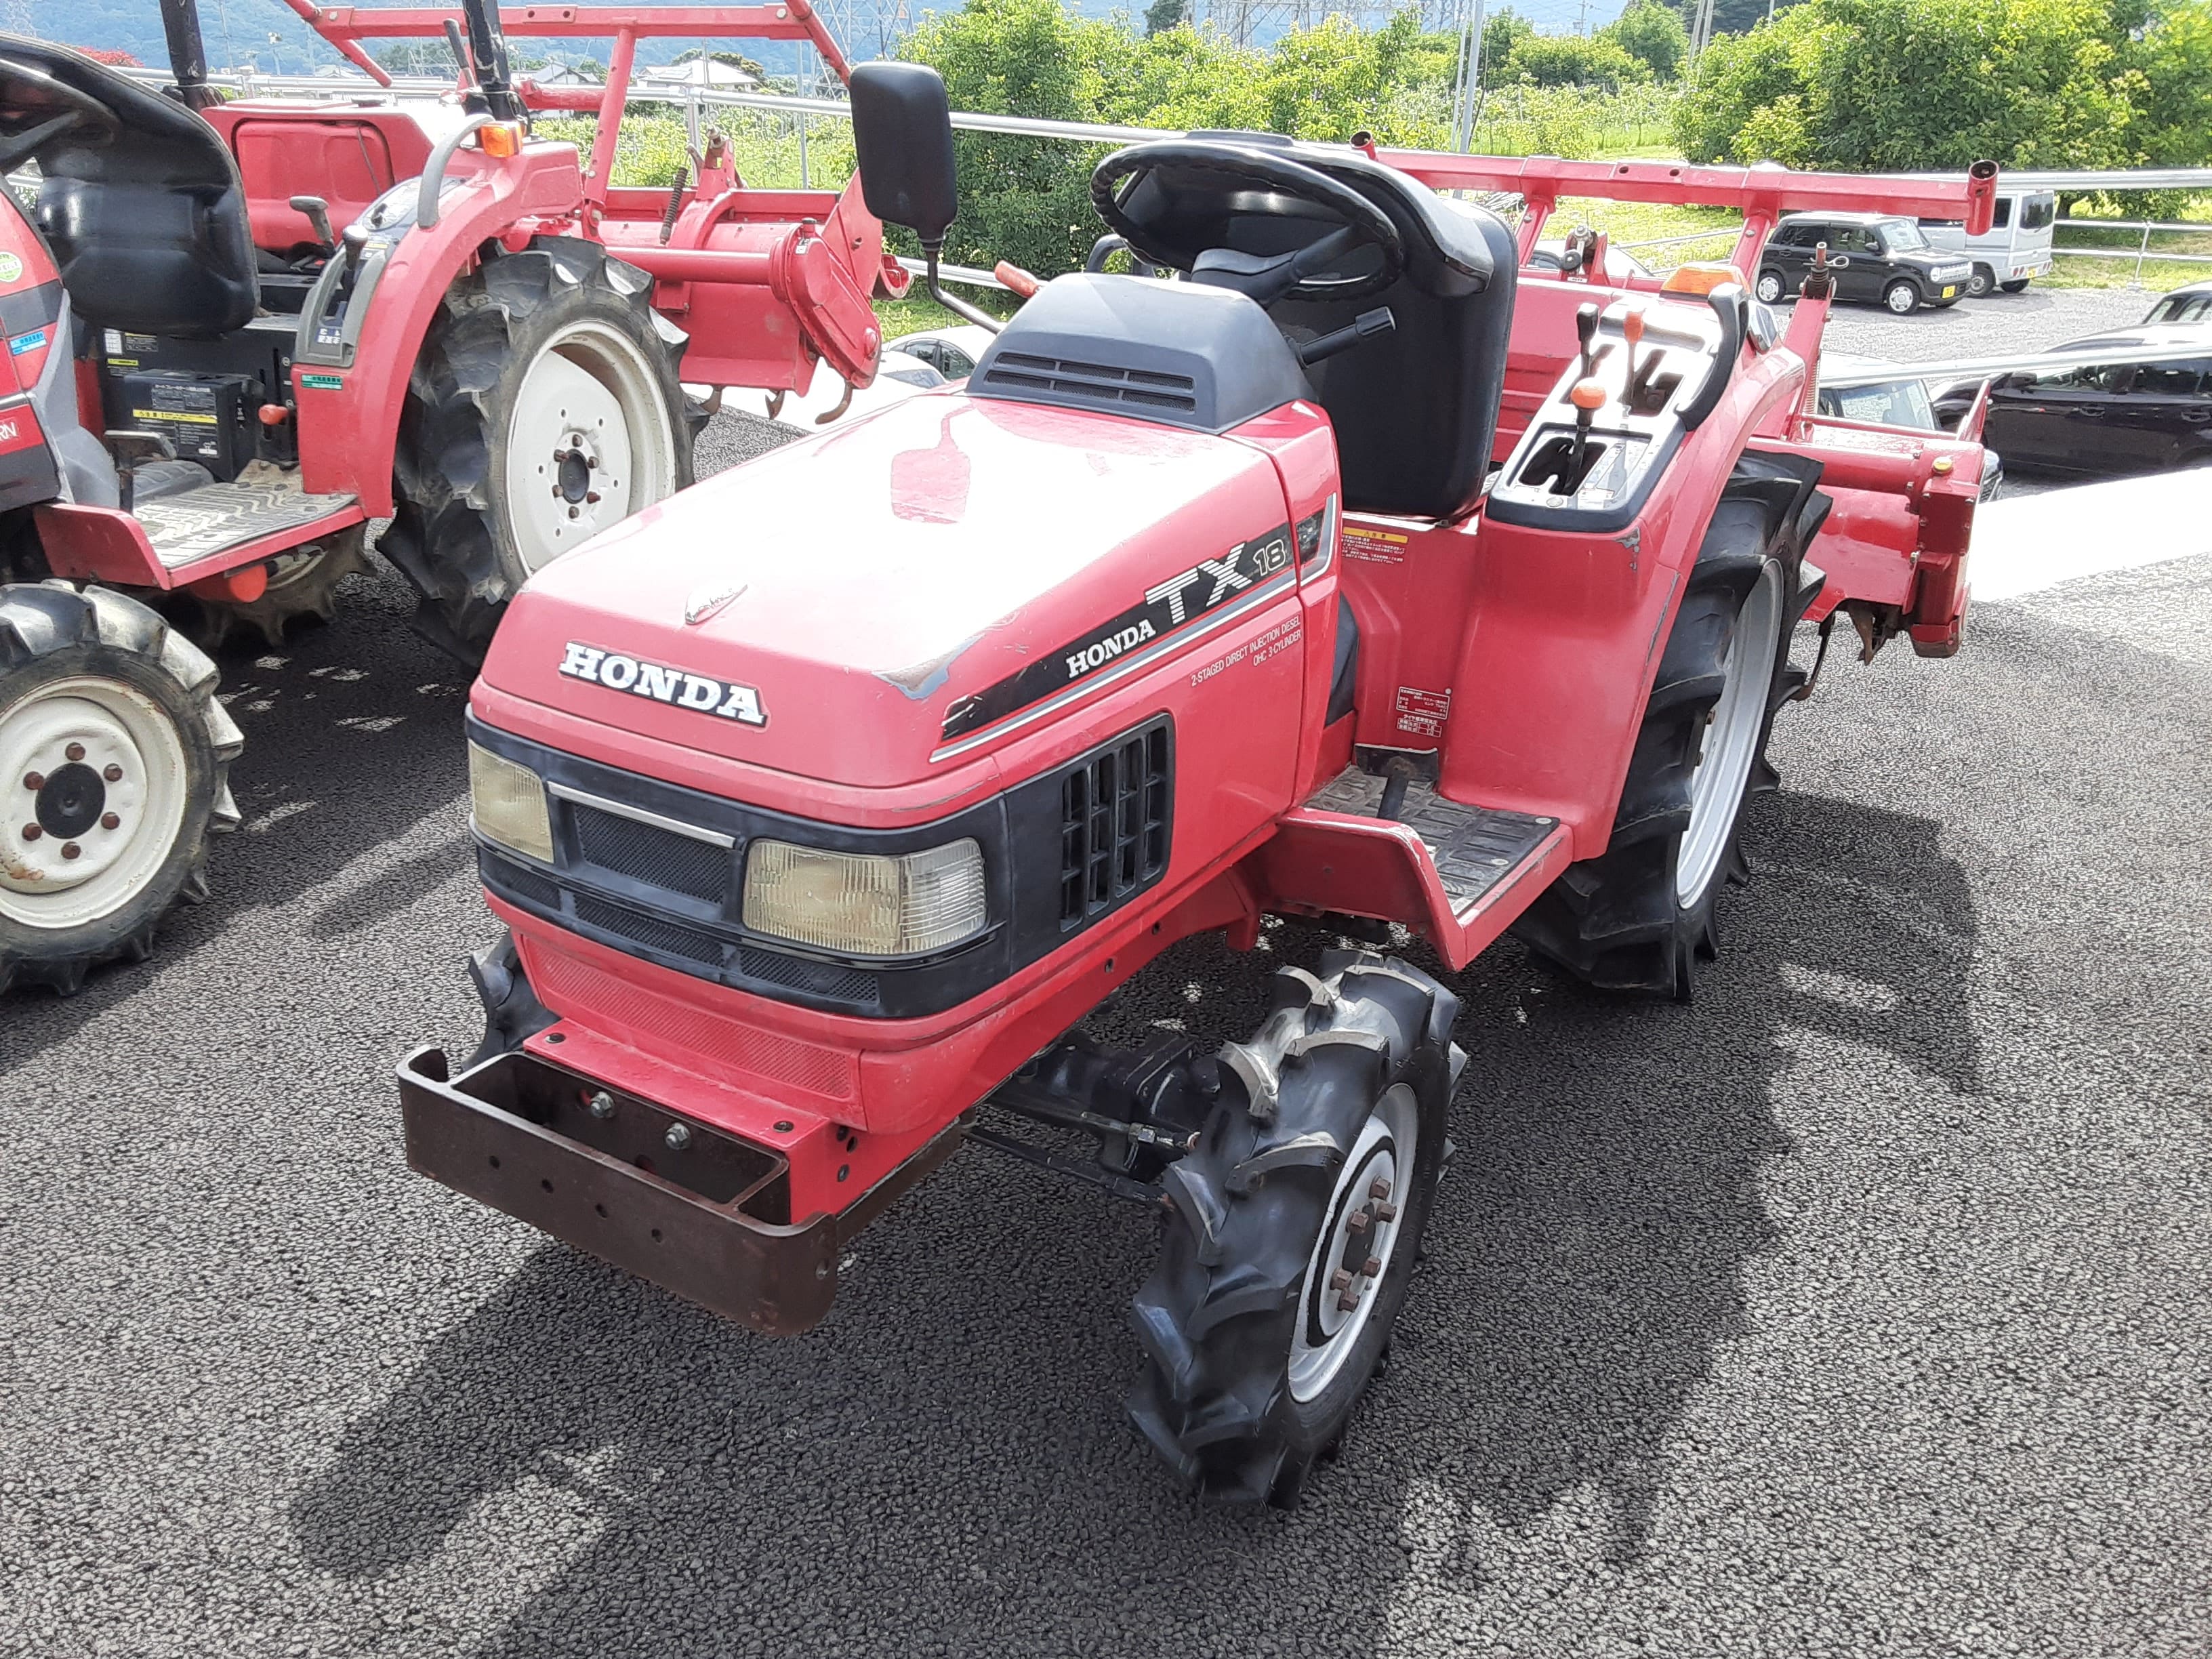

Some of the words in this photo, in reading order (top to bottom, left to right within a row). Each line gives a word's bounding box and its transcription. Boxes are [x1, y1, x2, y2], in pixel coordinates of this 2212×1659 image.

[1066, 619, 1155, 678] HONDA
[1145, 542, 1253, 625] TX
[1253, 539, 1286, 576] 18
[559, 641, 765, 724] HONDA
[1191, 659, 1225, 687] 2-STAGED
[1225, 647, 1248, 668] DIRECT
[1250, 627, 1280, 654] INJECTION
[1282, 615, 1300, 636] DIESEL
[1253, 651, 1267, 666] OHC
[1268, 630, 1302, 657] 3-CYLINDER
